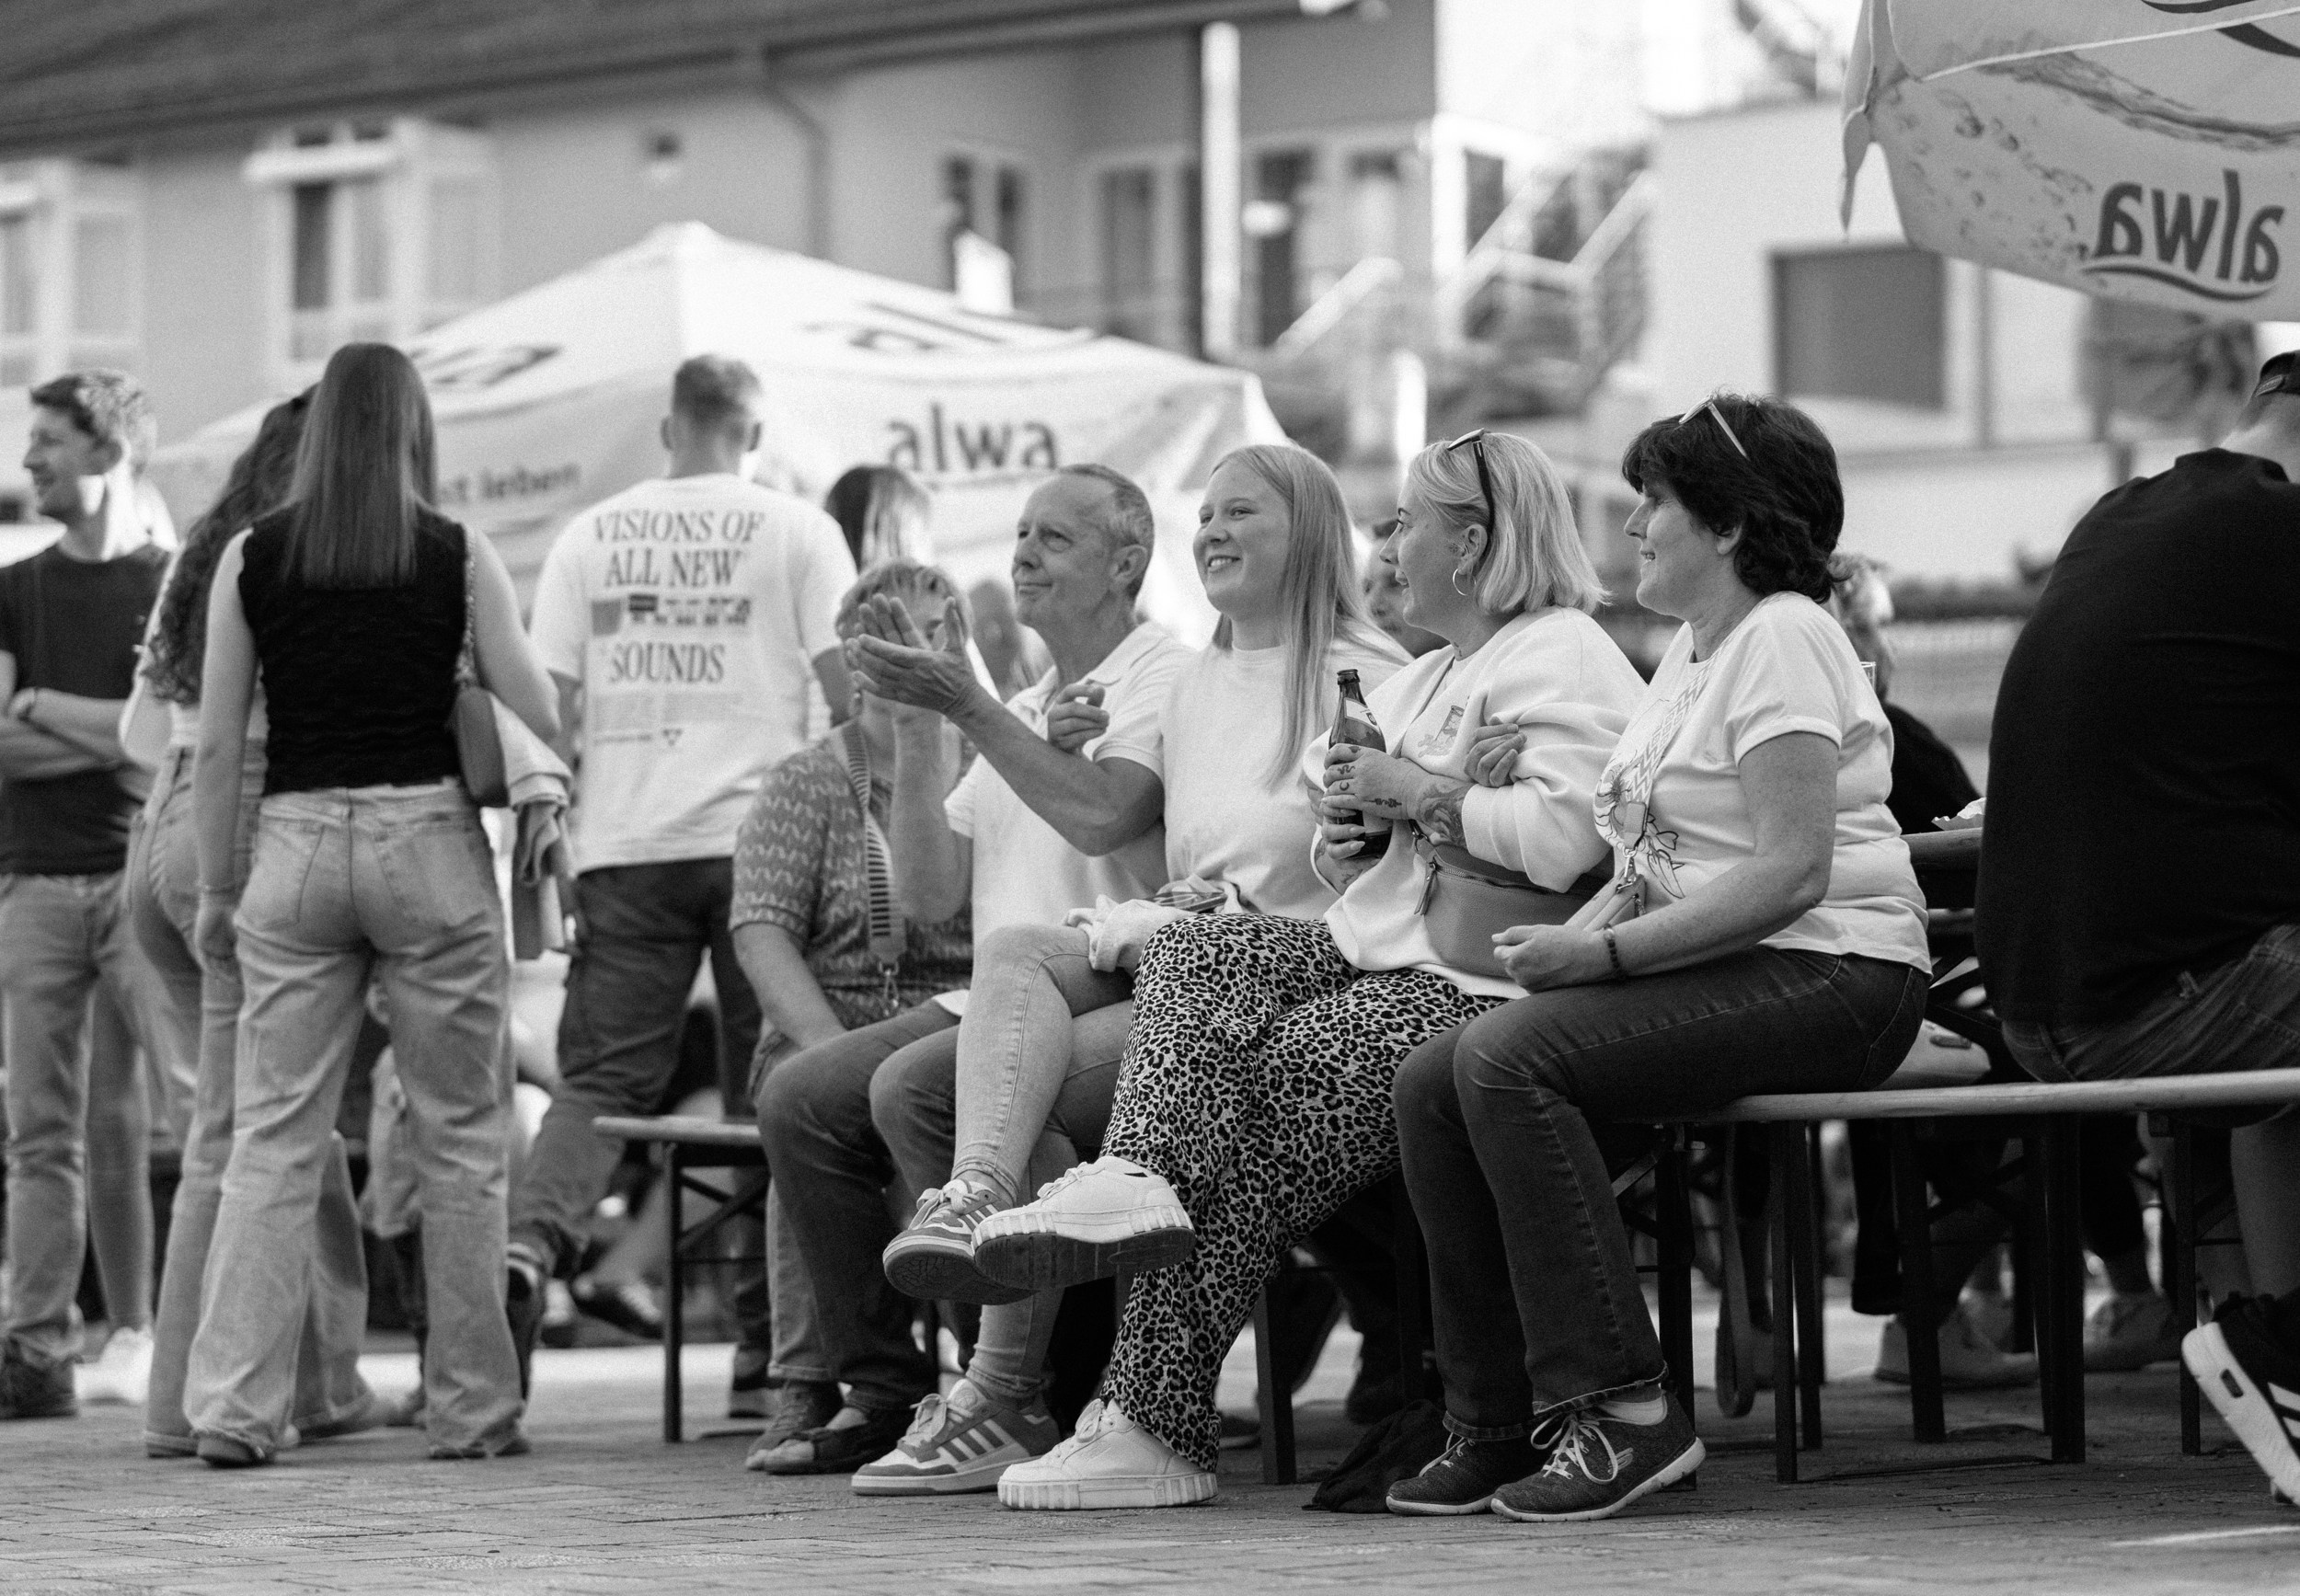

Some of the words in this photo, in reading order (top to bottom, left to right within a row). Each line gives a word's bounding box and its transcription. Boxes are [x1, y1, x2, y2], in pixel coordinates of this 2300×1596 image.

[889, 401, 1057, 472] alwa
[597, 510, 714, 542] VISIONS
[720, 511, 765, 542] OF
[604, 547, 661, 587] ALL
[669, 549, 742, 588] NEW
[608, 642, 725, 683] SOUNDS
